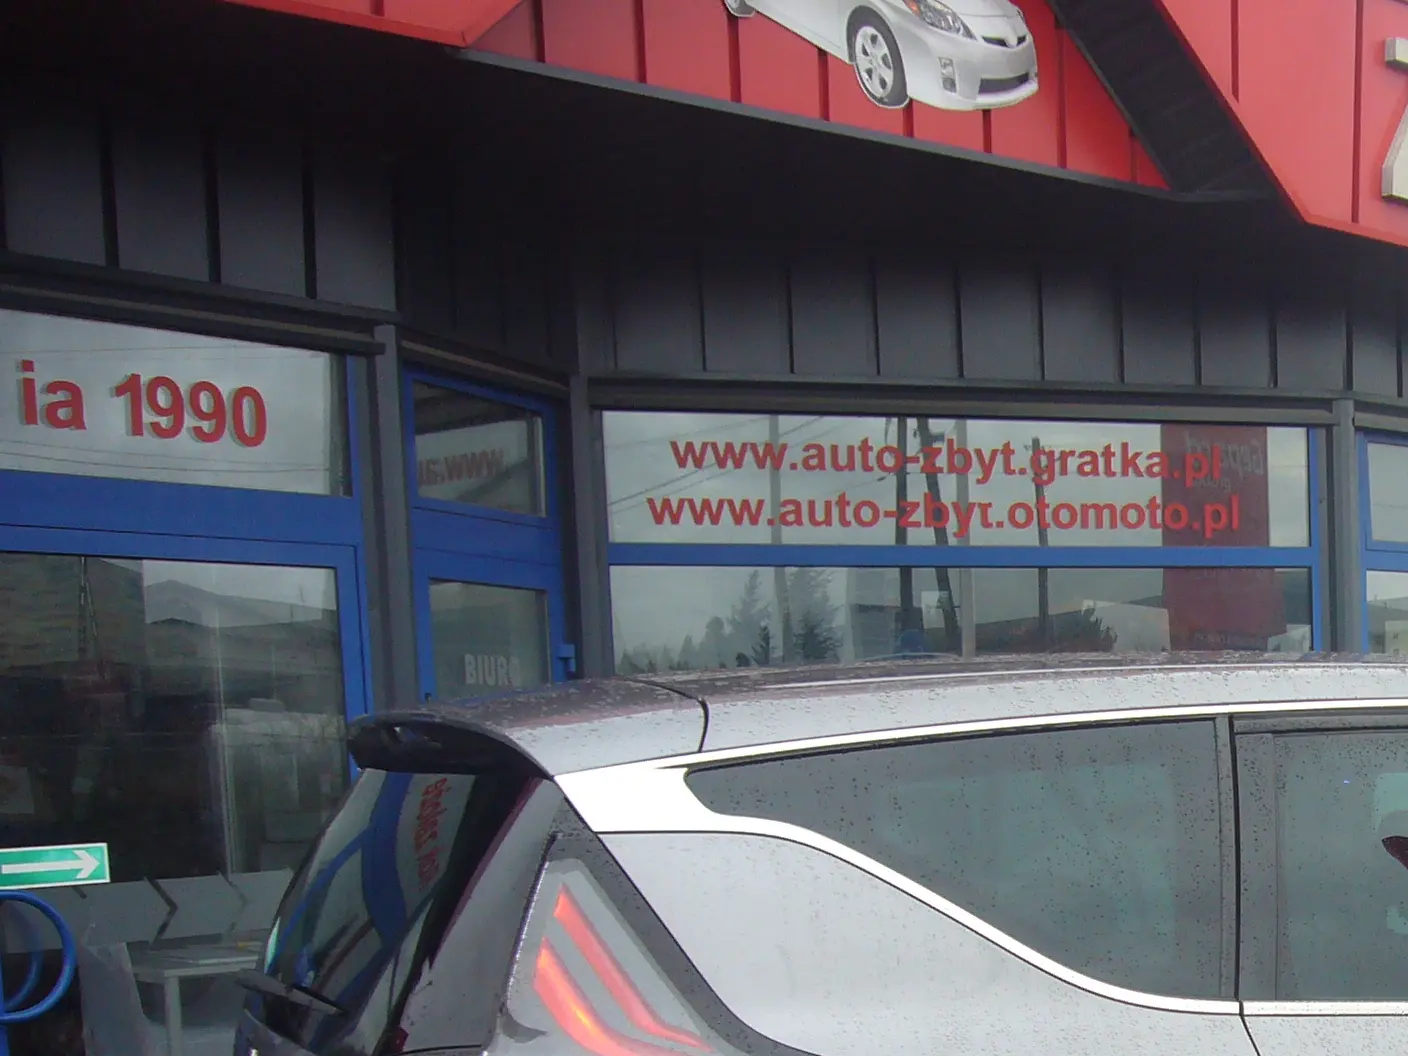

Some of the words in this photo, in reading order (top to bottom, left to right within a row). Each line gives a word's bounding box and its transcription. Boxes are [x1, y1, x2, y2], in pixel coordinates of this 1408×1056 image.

[19, 359, 87, 430] ia
[113, 373, 267, 447] 1990
[670, 436, 1222, 487] www.auto-zbyt.gratka.pl
[647, 491, 1240, 539] www.auto-zbyt.otomoto.pl
[464, 653, 522, 687] BIURO
